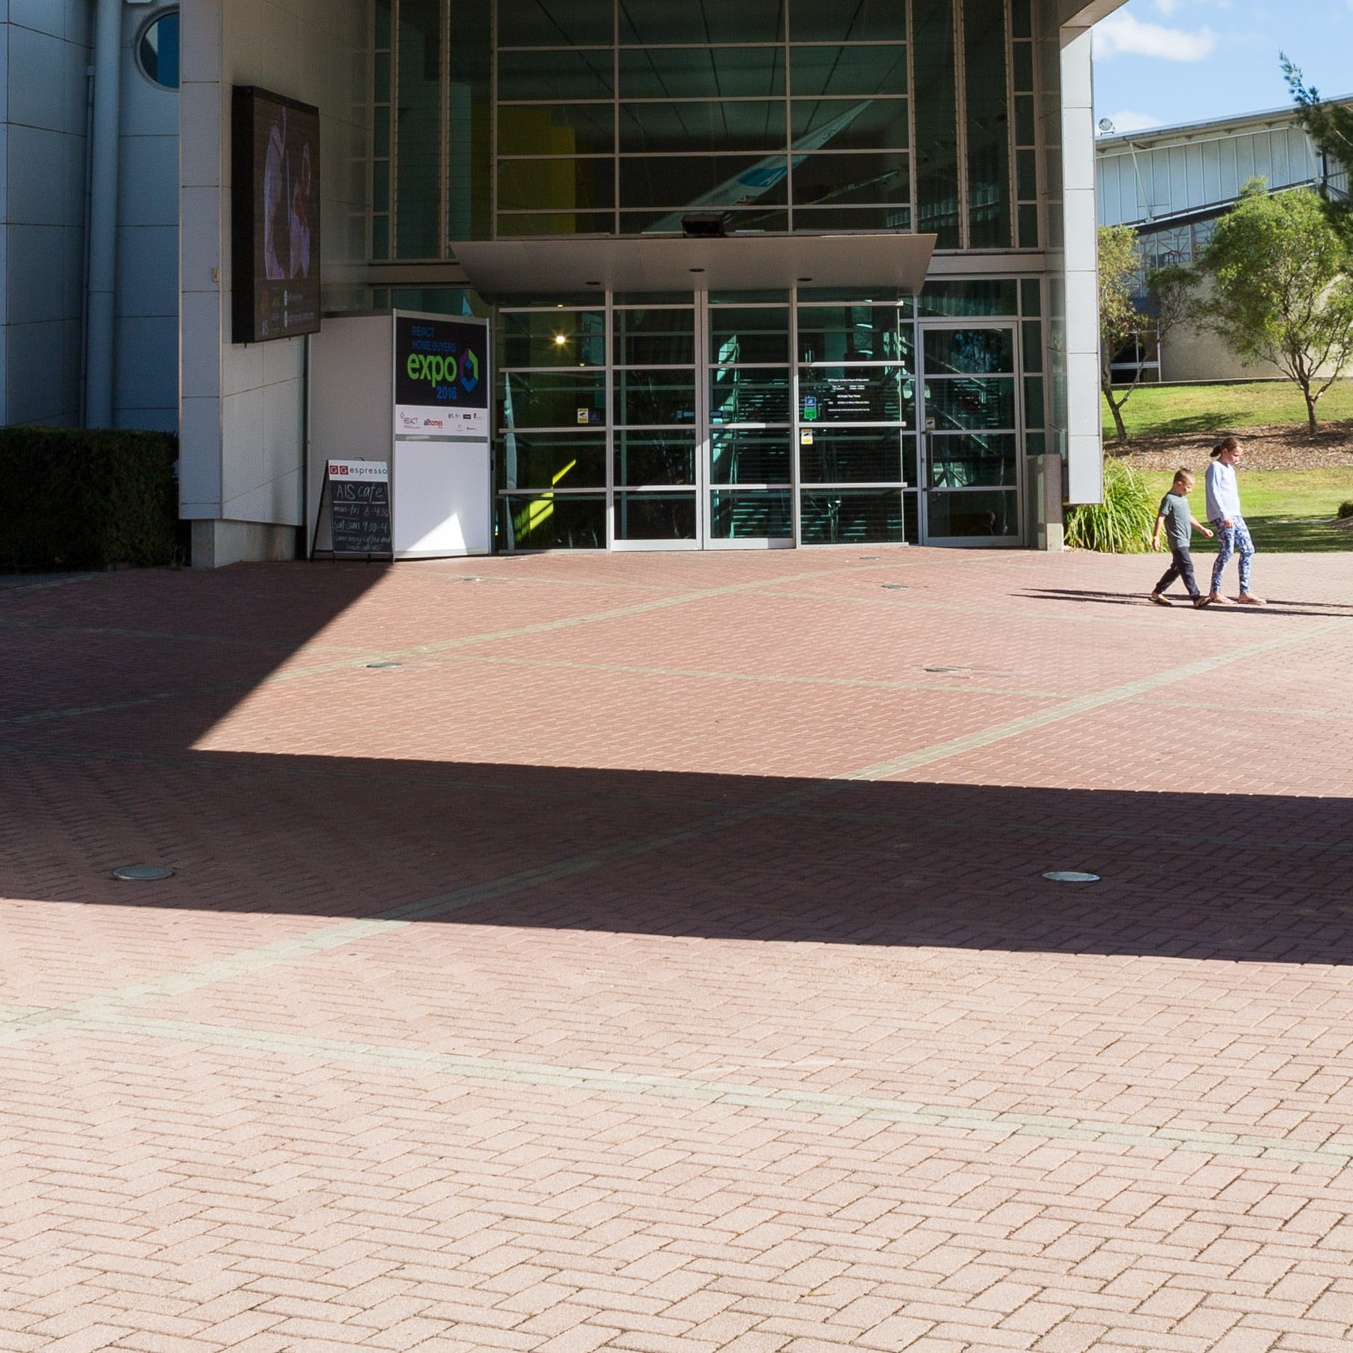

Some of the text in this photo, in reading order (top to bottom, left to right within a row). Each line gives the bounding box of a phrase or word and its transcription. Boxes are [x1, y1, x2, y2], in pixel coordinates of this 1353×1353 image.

[411, 339, 456, 353] HOME BUYERS
[406, 352, 458, 389] expo
[436, 385, 458, 400] 2016
[349, 467, 388, 476] espresso
[336, 483, 356, 500] AIS
